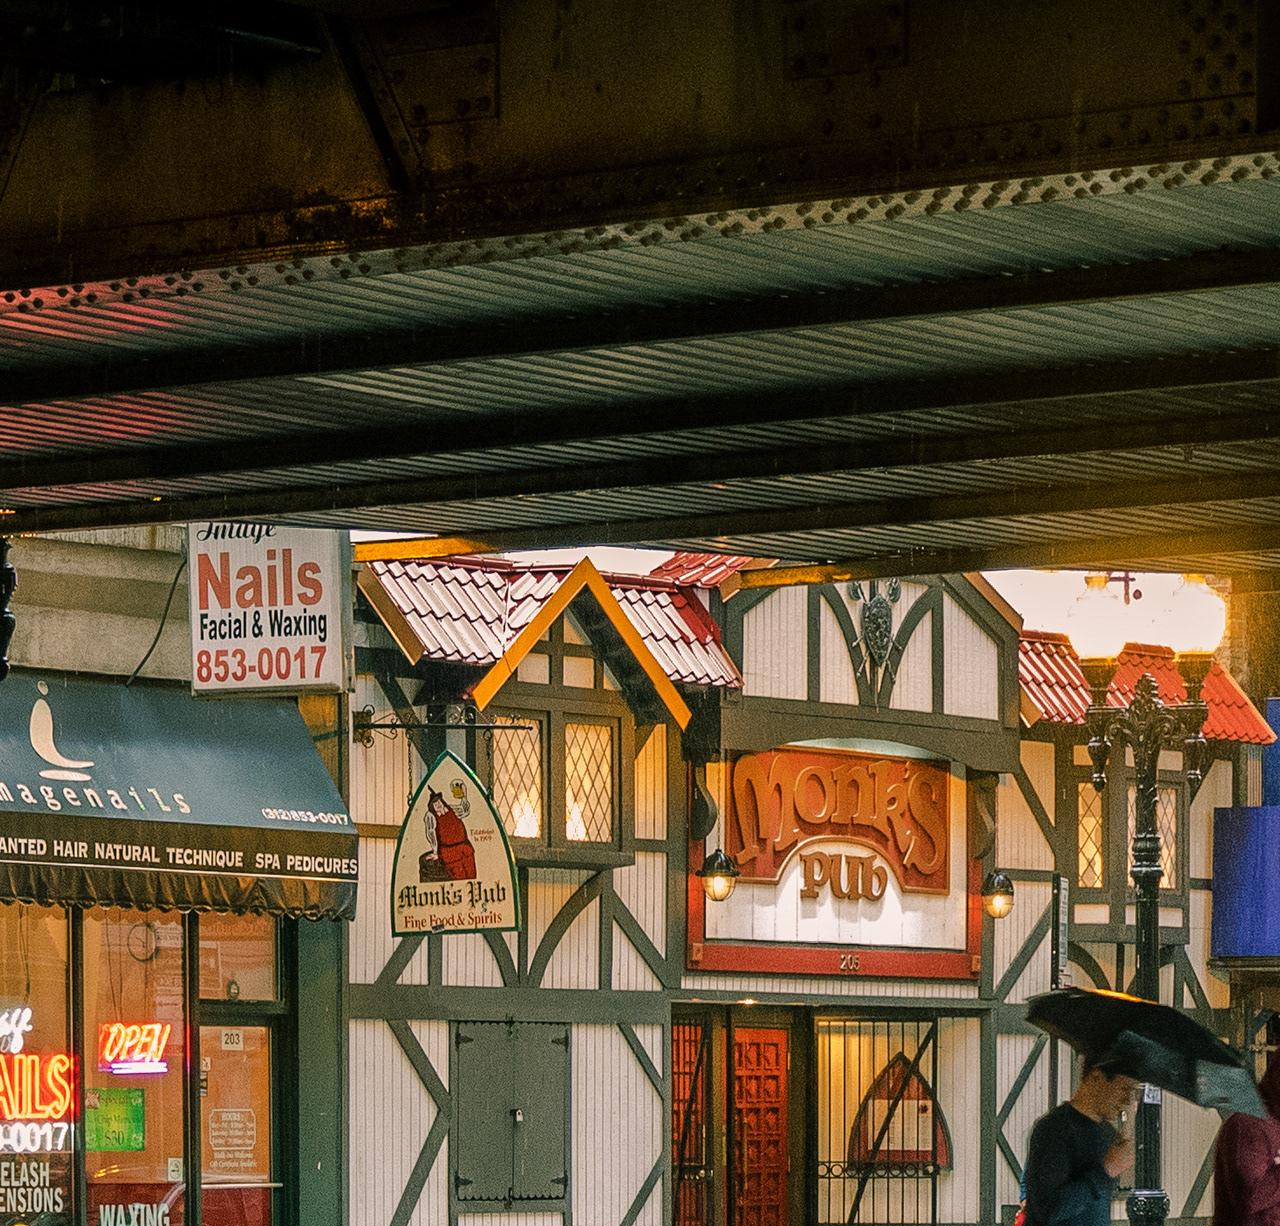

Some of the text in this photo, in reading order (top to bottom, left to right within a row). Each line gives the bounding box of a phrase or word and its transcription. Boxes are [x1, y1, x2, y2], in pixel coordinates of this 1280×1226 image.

[197, 548, 323, 610] Nails
[200, 608, 327, 642] Facial & Waxing
[197, 646, 326, 682] 853-0017
[261, 807, 348, 826] (312)853-0017
[53, 840, 88, 858] HAIR
[95, 843, 160, 863] NATURAL
[166, 847, 244, 868] TECHNIQUE
[255, 853, 281, 870] SPA
[286, 855, 358, 874] PEDICURES
[398, 880, 506, 908] Monk's Pub
[404, 911, 502, 930] Fine Food & Spirits
[840, 955, 860, 970] 205
[104, 1023, 171, 1063] OPEN
[224, 1033, 241, 1045] 203
